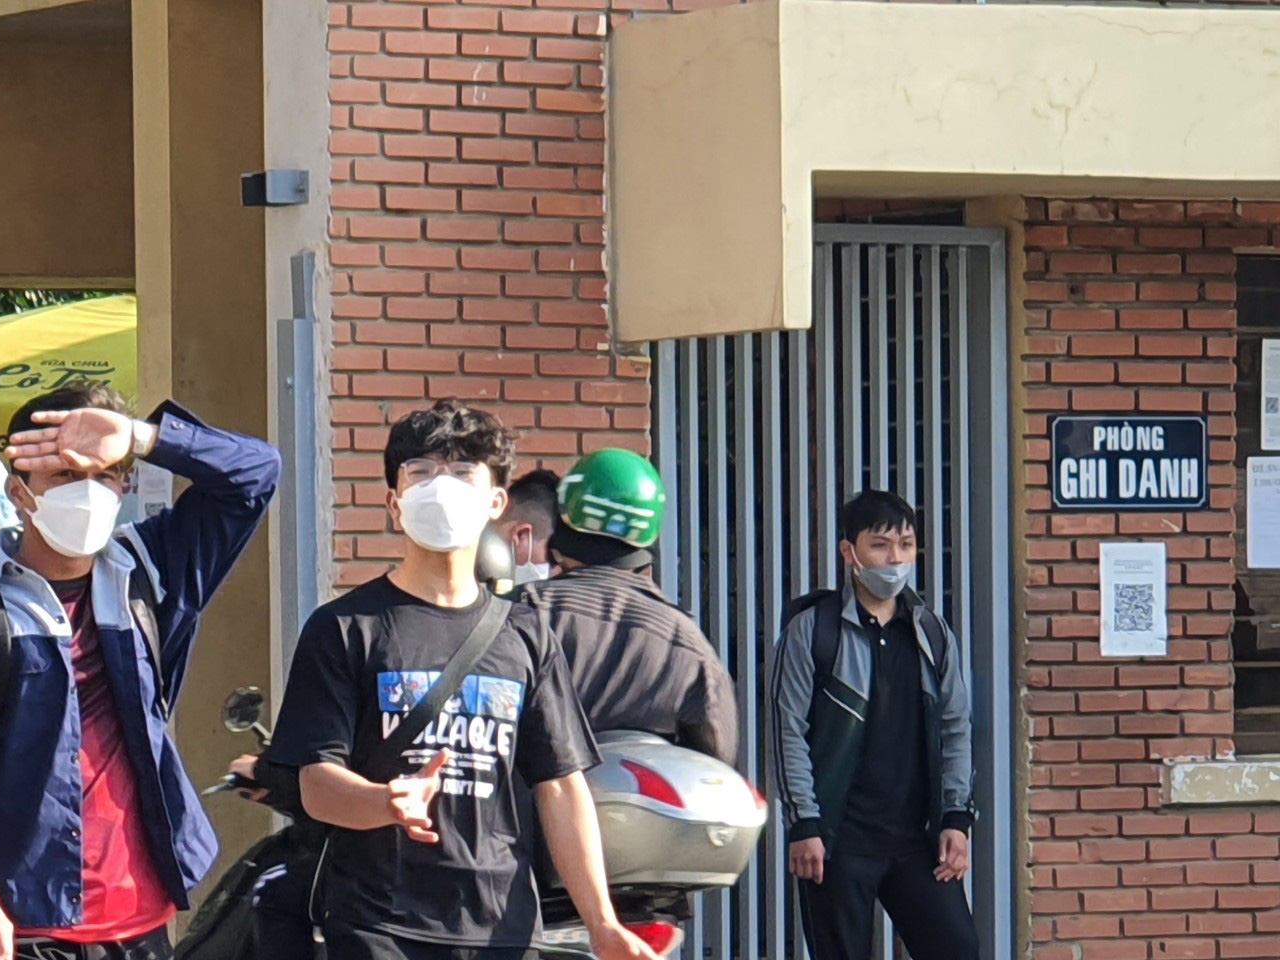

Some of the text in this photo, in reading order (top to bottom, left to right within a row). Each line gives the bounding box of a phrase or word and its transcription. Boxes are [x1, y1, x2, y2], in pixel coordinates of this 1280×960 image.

[1093, 421, 1165, 451] PHÒNG
[1060, 458, 1199, 499] GHI DANH
